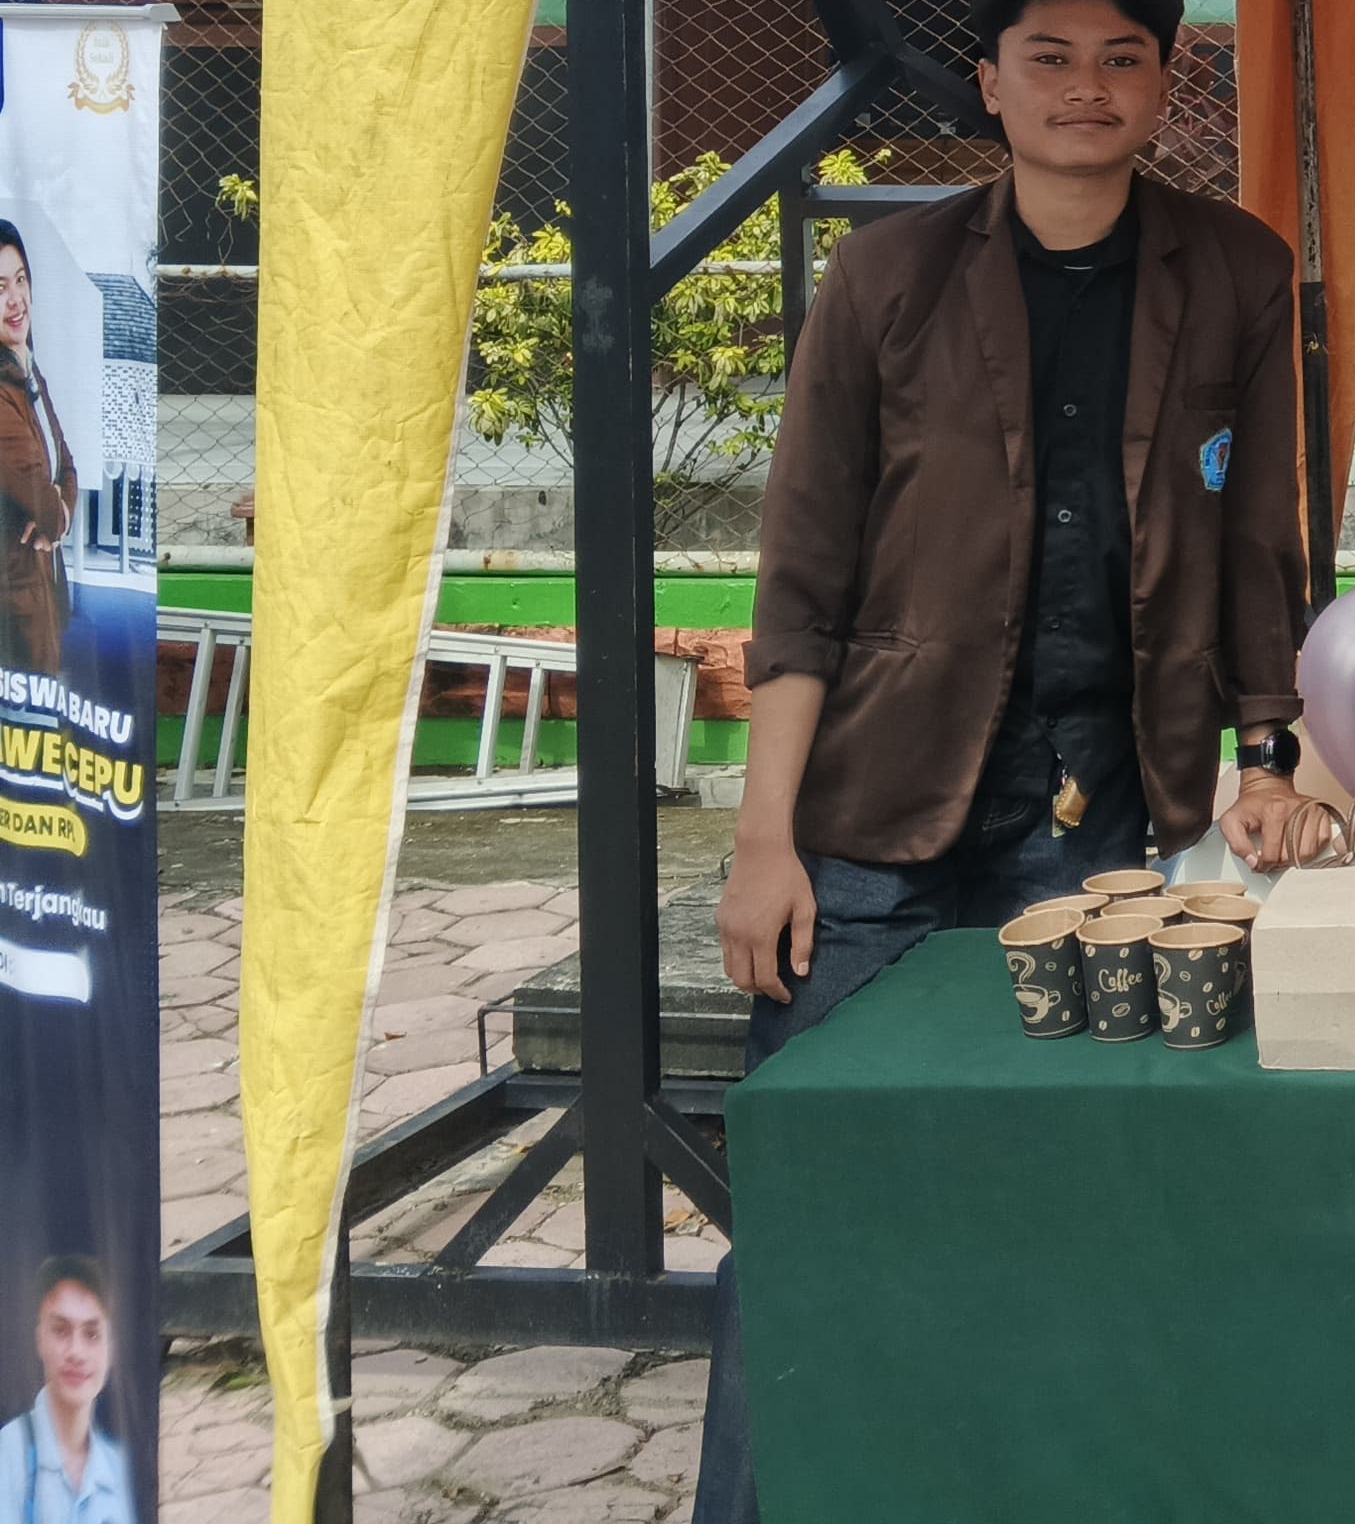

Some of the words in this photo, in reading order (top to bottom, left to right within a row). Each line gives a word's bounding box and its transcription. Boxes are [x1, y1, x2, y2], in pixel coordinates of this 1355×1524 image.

[69, 692, 132, 744] BARU
[65, 742, 143, 805] CEPU
[13, 812, 53, 836] DAN
[1098, 968, 1143, 993] Coffee
